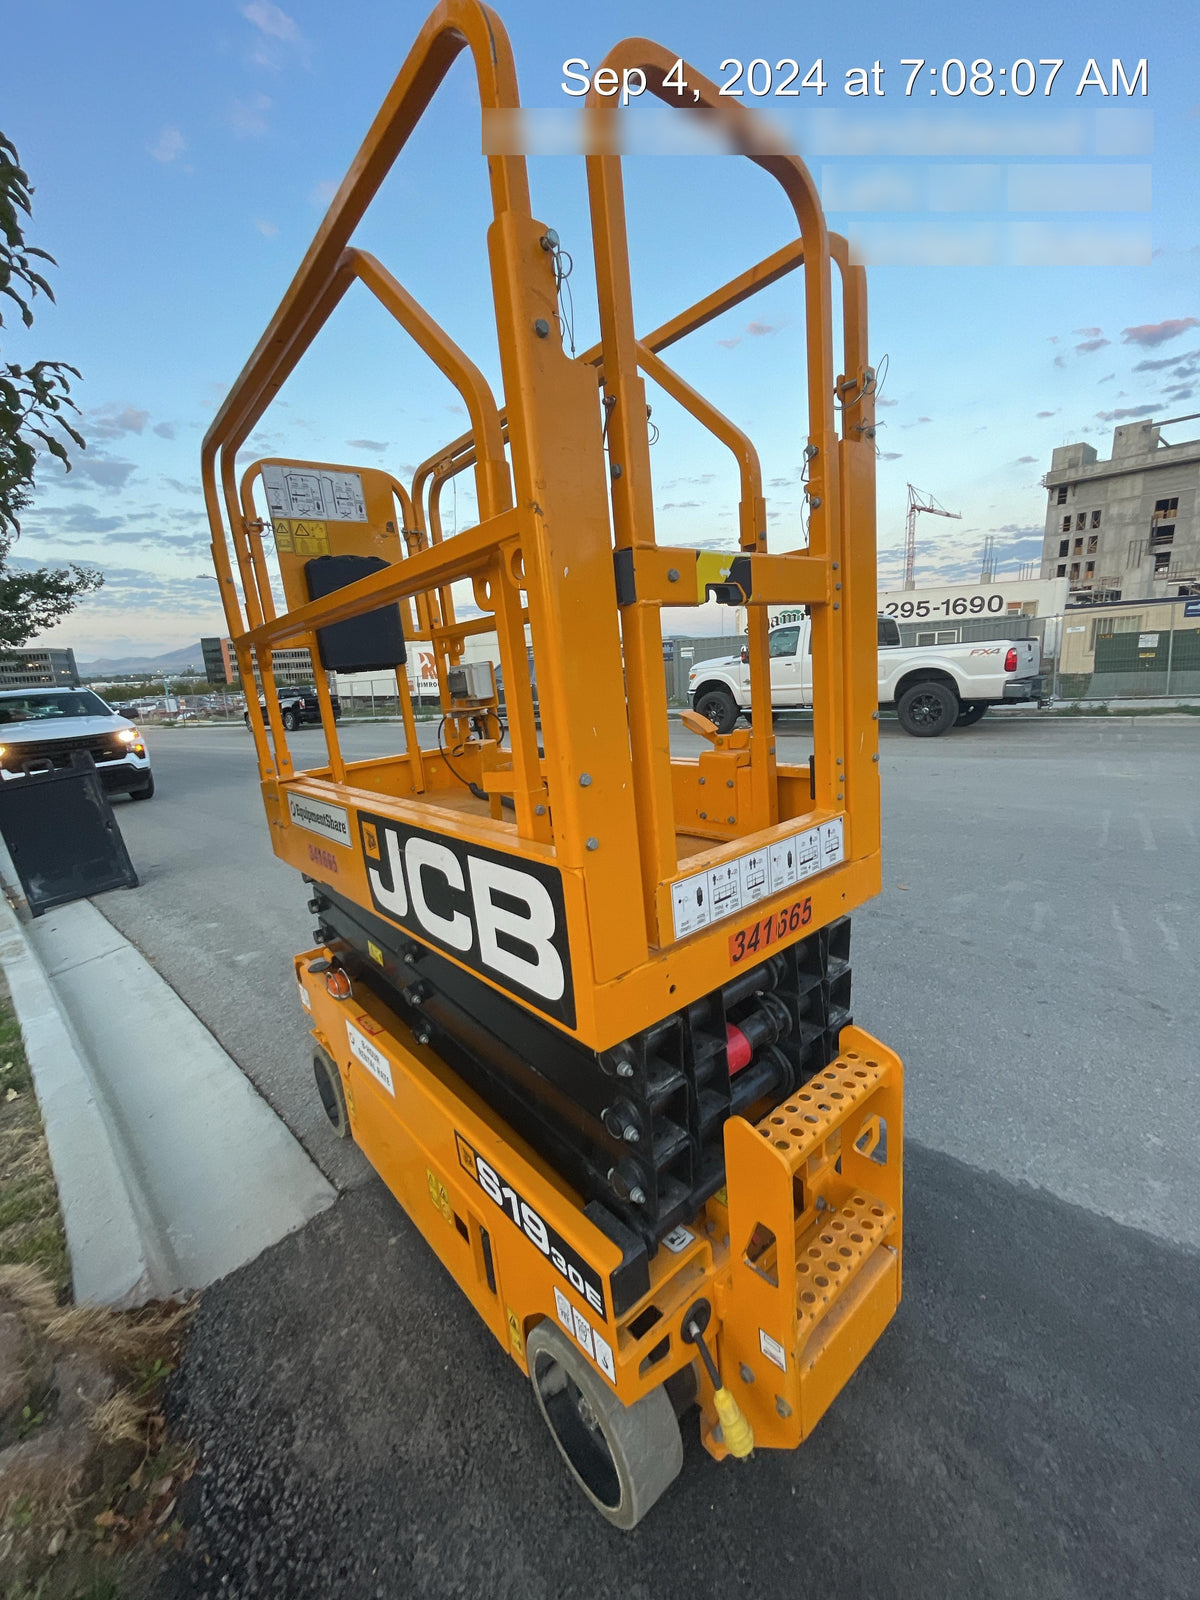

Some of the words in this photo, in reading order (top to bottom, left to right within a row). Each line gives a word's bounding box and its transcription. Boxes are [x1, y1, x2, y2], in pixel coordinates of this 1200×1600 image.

[970, 647, 1002, 657] FX4
[295, 803, 347, 835] EquipmentShare
[368, 827, 565, 1001] JCB
[732, 895, 813, 962] 341665
